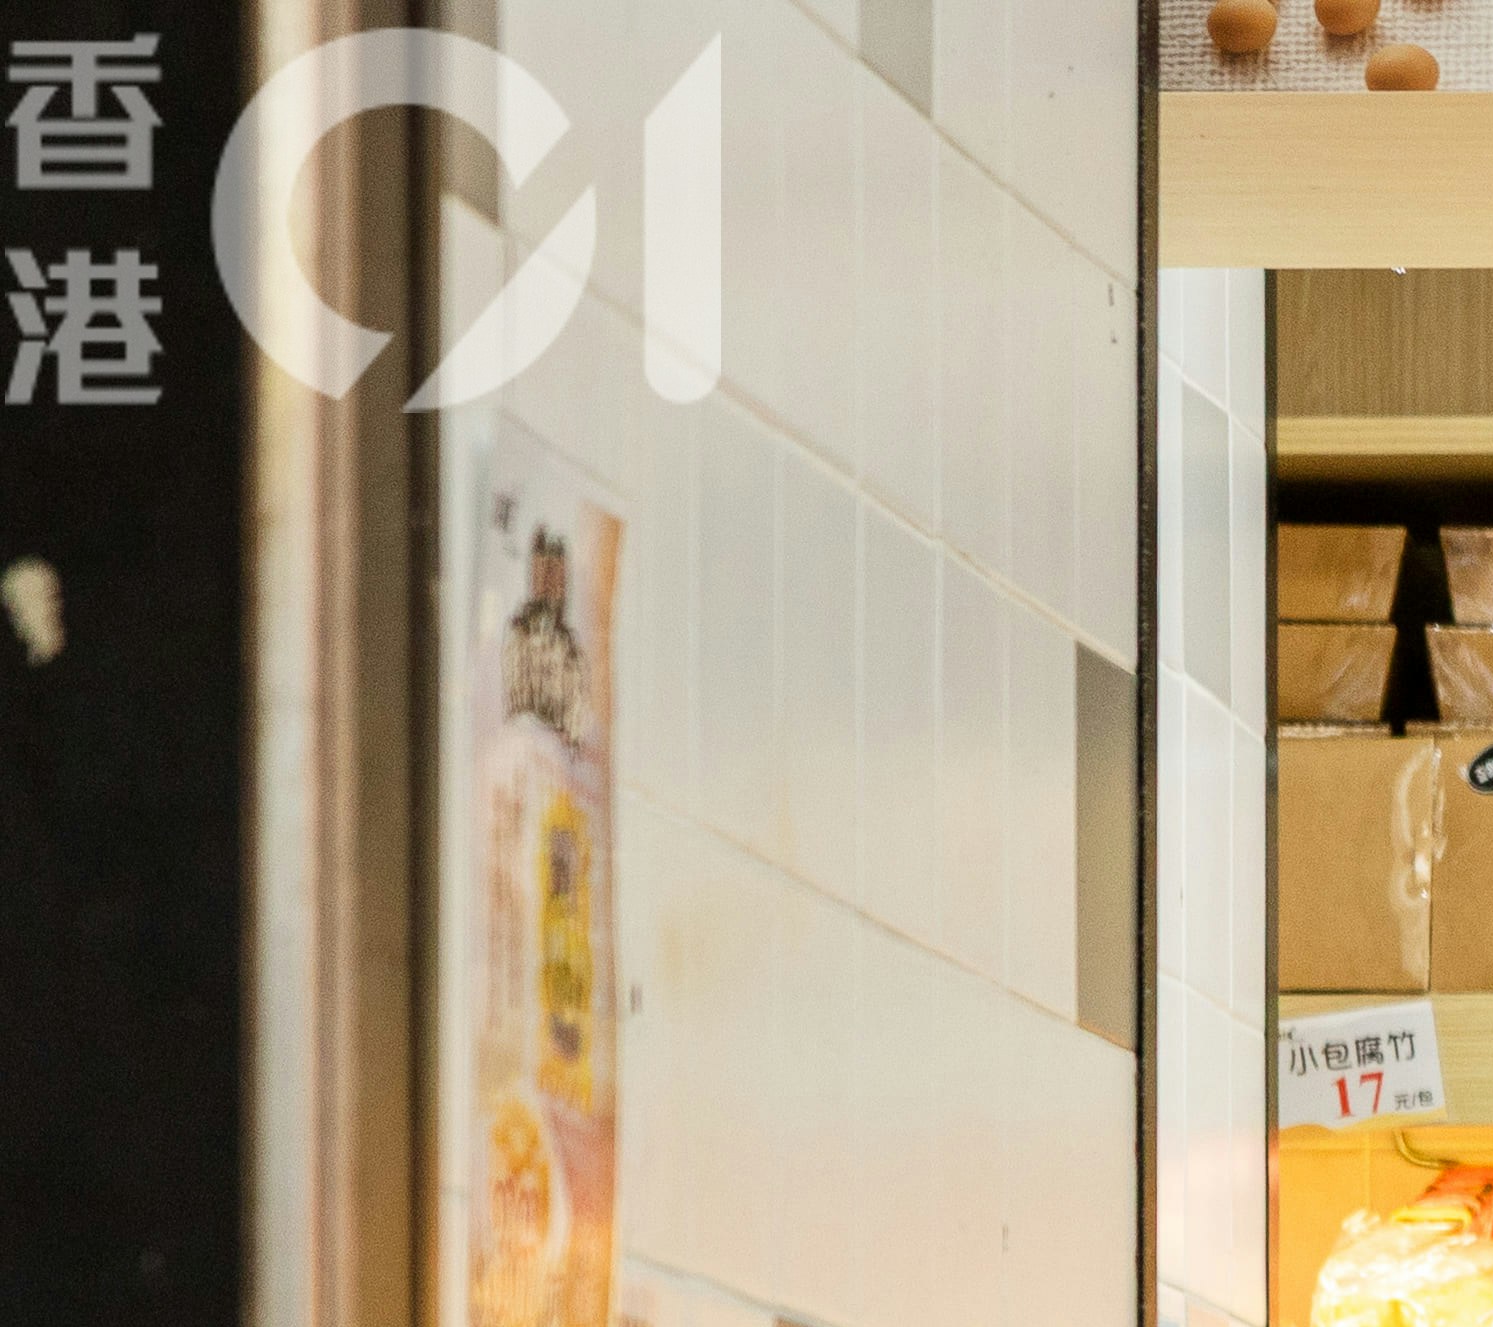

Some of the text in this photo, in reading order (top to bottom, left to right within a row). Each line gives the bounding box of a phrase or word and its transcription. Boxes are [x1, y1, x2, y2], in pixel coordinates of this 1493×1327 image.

[1290, 1031, 1416, 1077] 小包腐竹
[1332, 1071, 1385, 1118] 17
